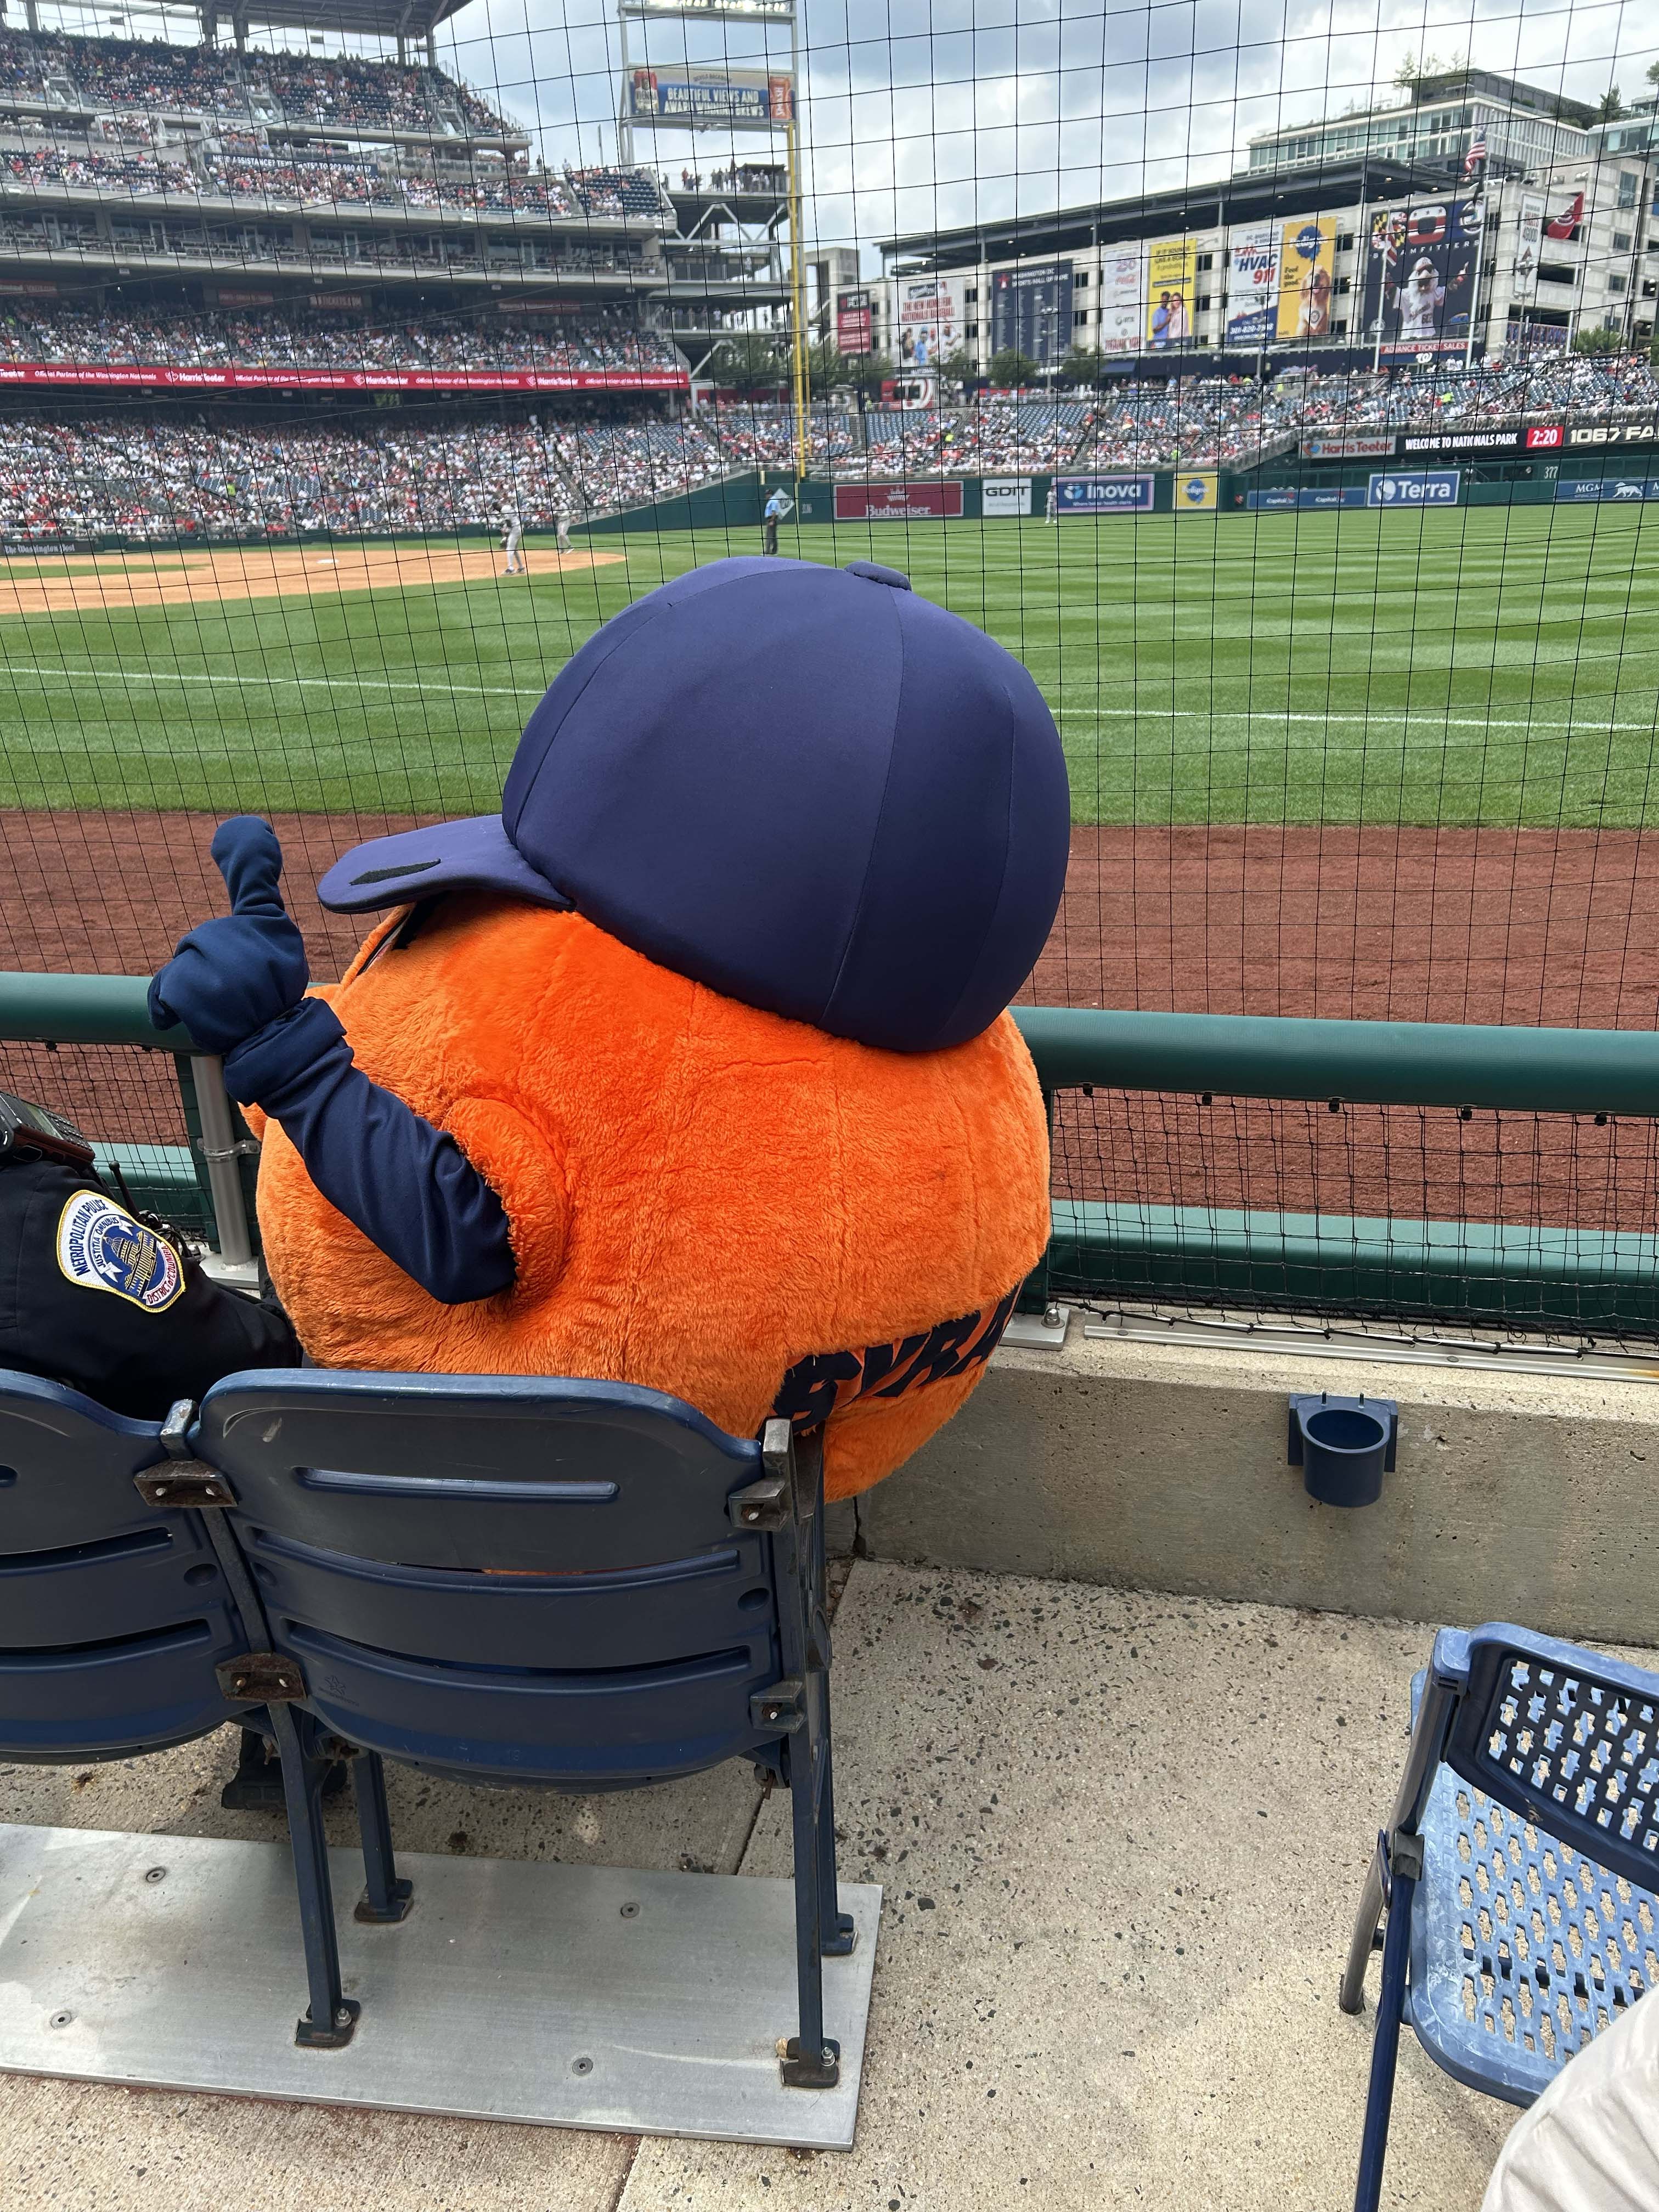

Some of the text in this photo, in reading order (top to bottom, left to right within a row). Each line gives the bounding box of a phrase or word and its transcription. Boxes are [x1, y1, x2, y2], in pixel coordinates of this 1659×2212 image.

[668, 87, 759, 103] BEAUTIFUL VIEWS AND
[212, 155, 230, 163] NEED
[1373, 239, 1480, 259] SAMFITTERS
[1238, 253, 1278, 272] HVAC
[1253, 267, 1277, 284] 911
[1384, 345, 1415, 353] ADVANCE
[1418, 343, 1441, 352] TICKET
[1532, 429, 1558, 445] 2:20
[1625, 425, 1659, 441] FA
[1406, 433, 1518, 450] WELCOME TO NATIONALS PARK
[1544, 466, 1559, 479] 377
[986, 486, 1028, 496] GDIT
[1086, 483, 1141, 499] Inova
[1397, 479, 1451, 499] Terra
[1576, 483, 1604, 494] MGM
[865, 505, 930, 517] Budweiser
[4, 544, 75, 555] The Washington Post
[69, 1199, 109, 1277] METROPOLITAN POLICE
[92, 1216, 119, 1268] JUSTITIA OMNIBUS
[146, 1281, 171, 1305] DISTRICT
